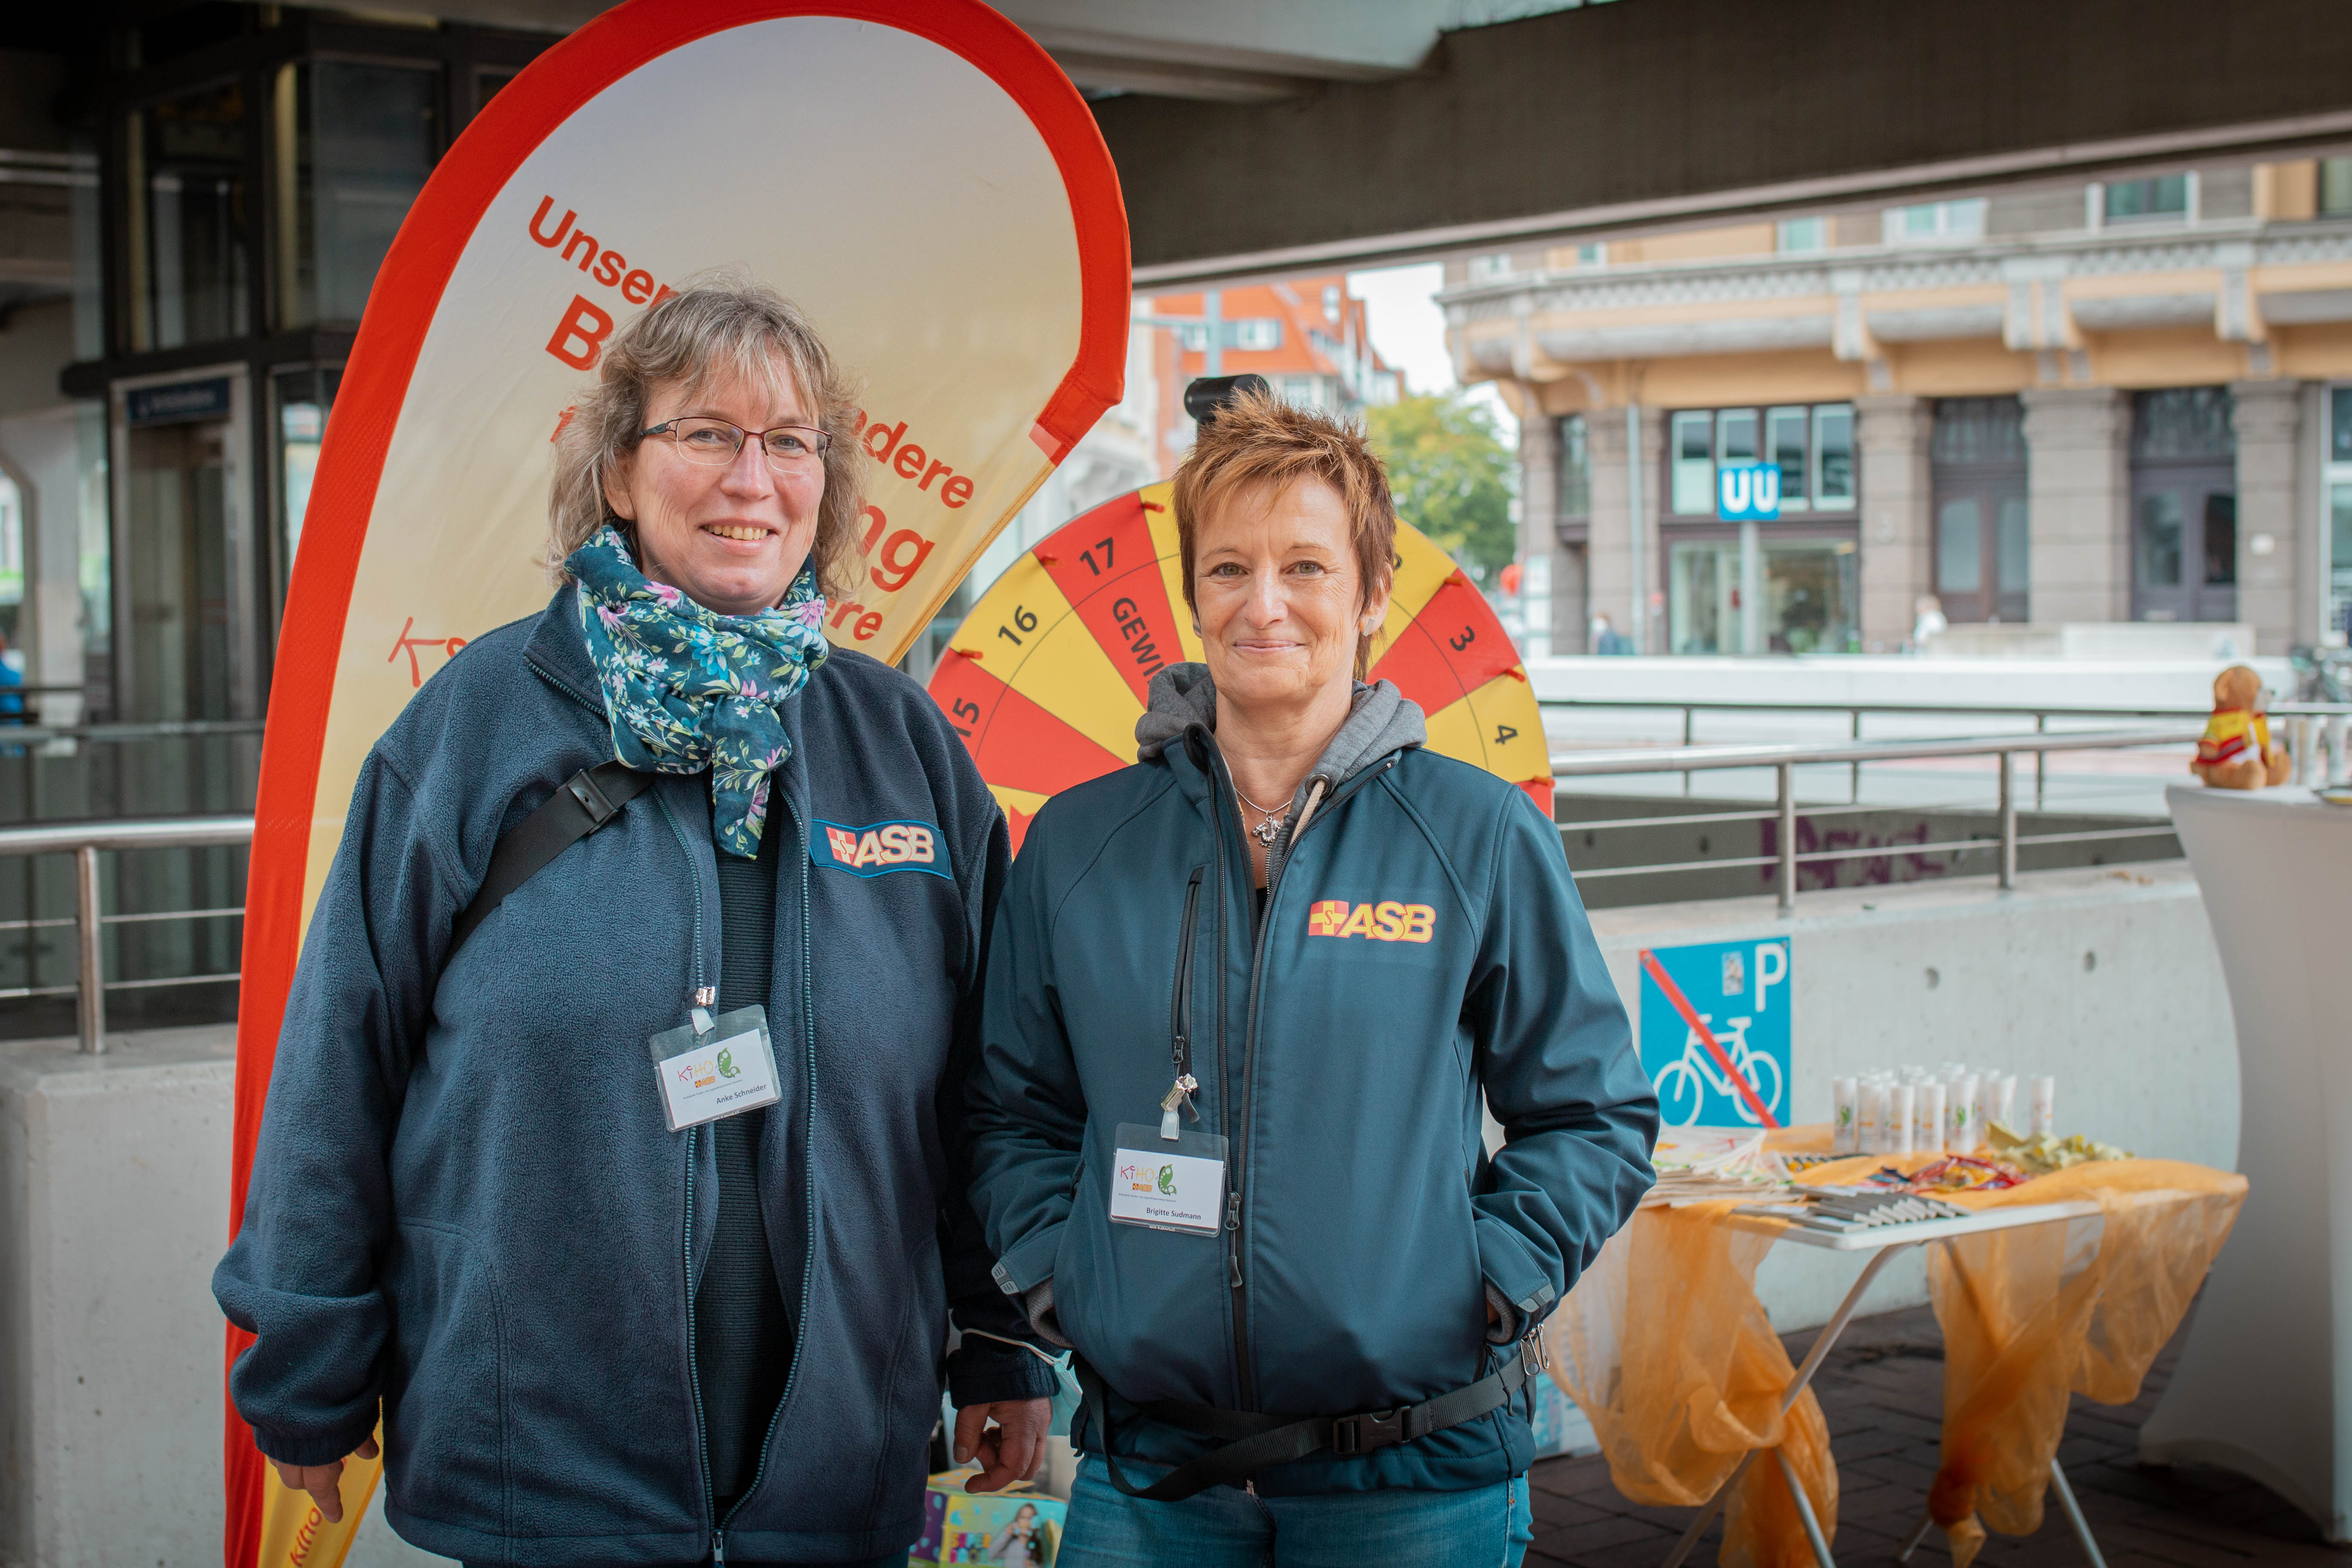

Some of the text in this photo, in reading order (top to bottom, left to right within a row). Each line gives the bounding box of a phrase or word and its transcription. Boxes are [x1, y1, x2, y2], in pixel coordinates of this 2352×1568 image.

[1080, 537, 1114, 576] 17
[998, 605, 1037, 646] 16
[1113, 597, 1164, 683] GEWI
[1450, 626, 1475, 651] 3
[1495, 725, 1518, 744] 4
[852, 825, 934, 868] ASB
[1336, 901, 1436, 943] ASB
[1755, 943, 1788, 1012] P
[717, 1095, 733, 1104] Anke
[734, 1084, 767, 1099] Schneider
[1146, 1207, 1201, 1220] Brigitte Sudmann
